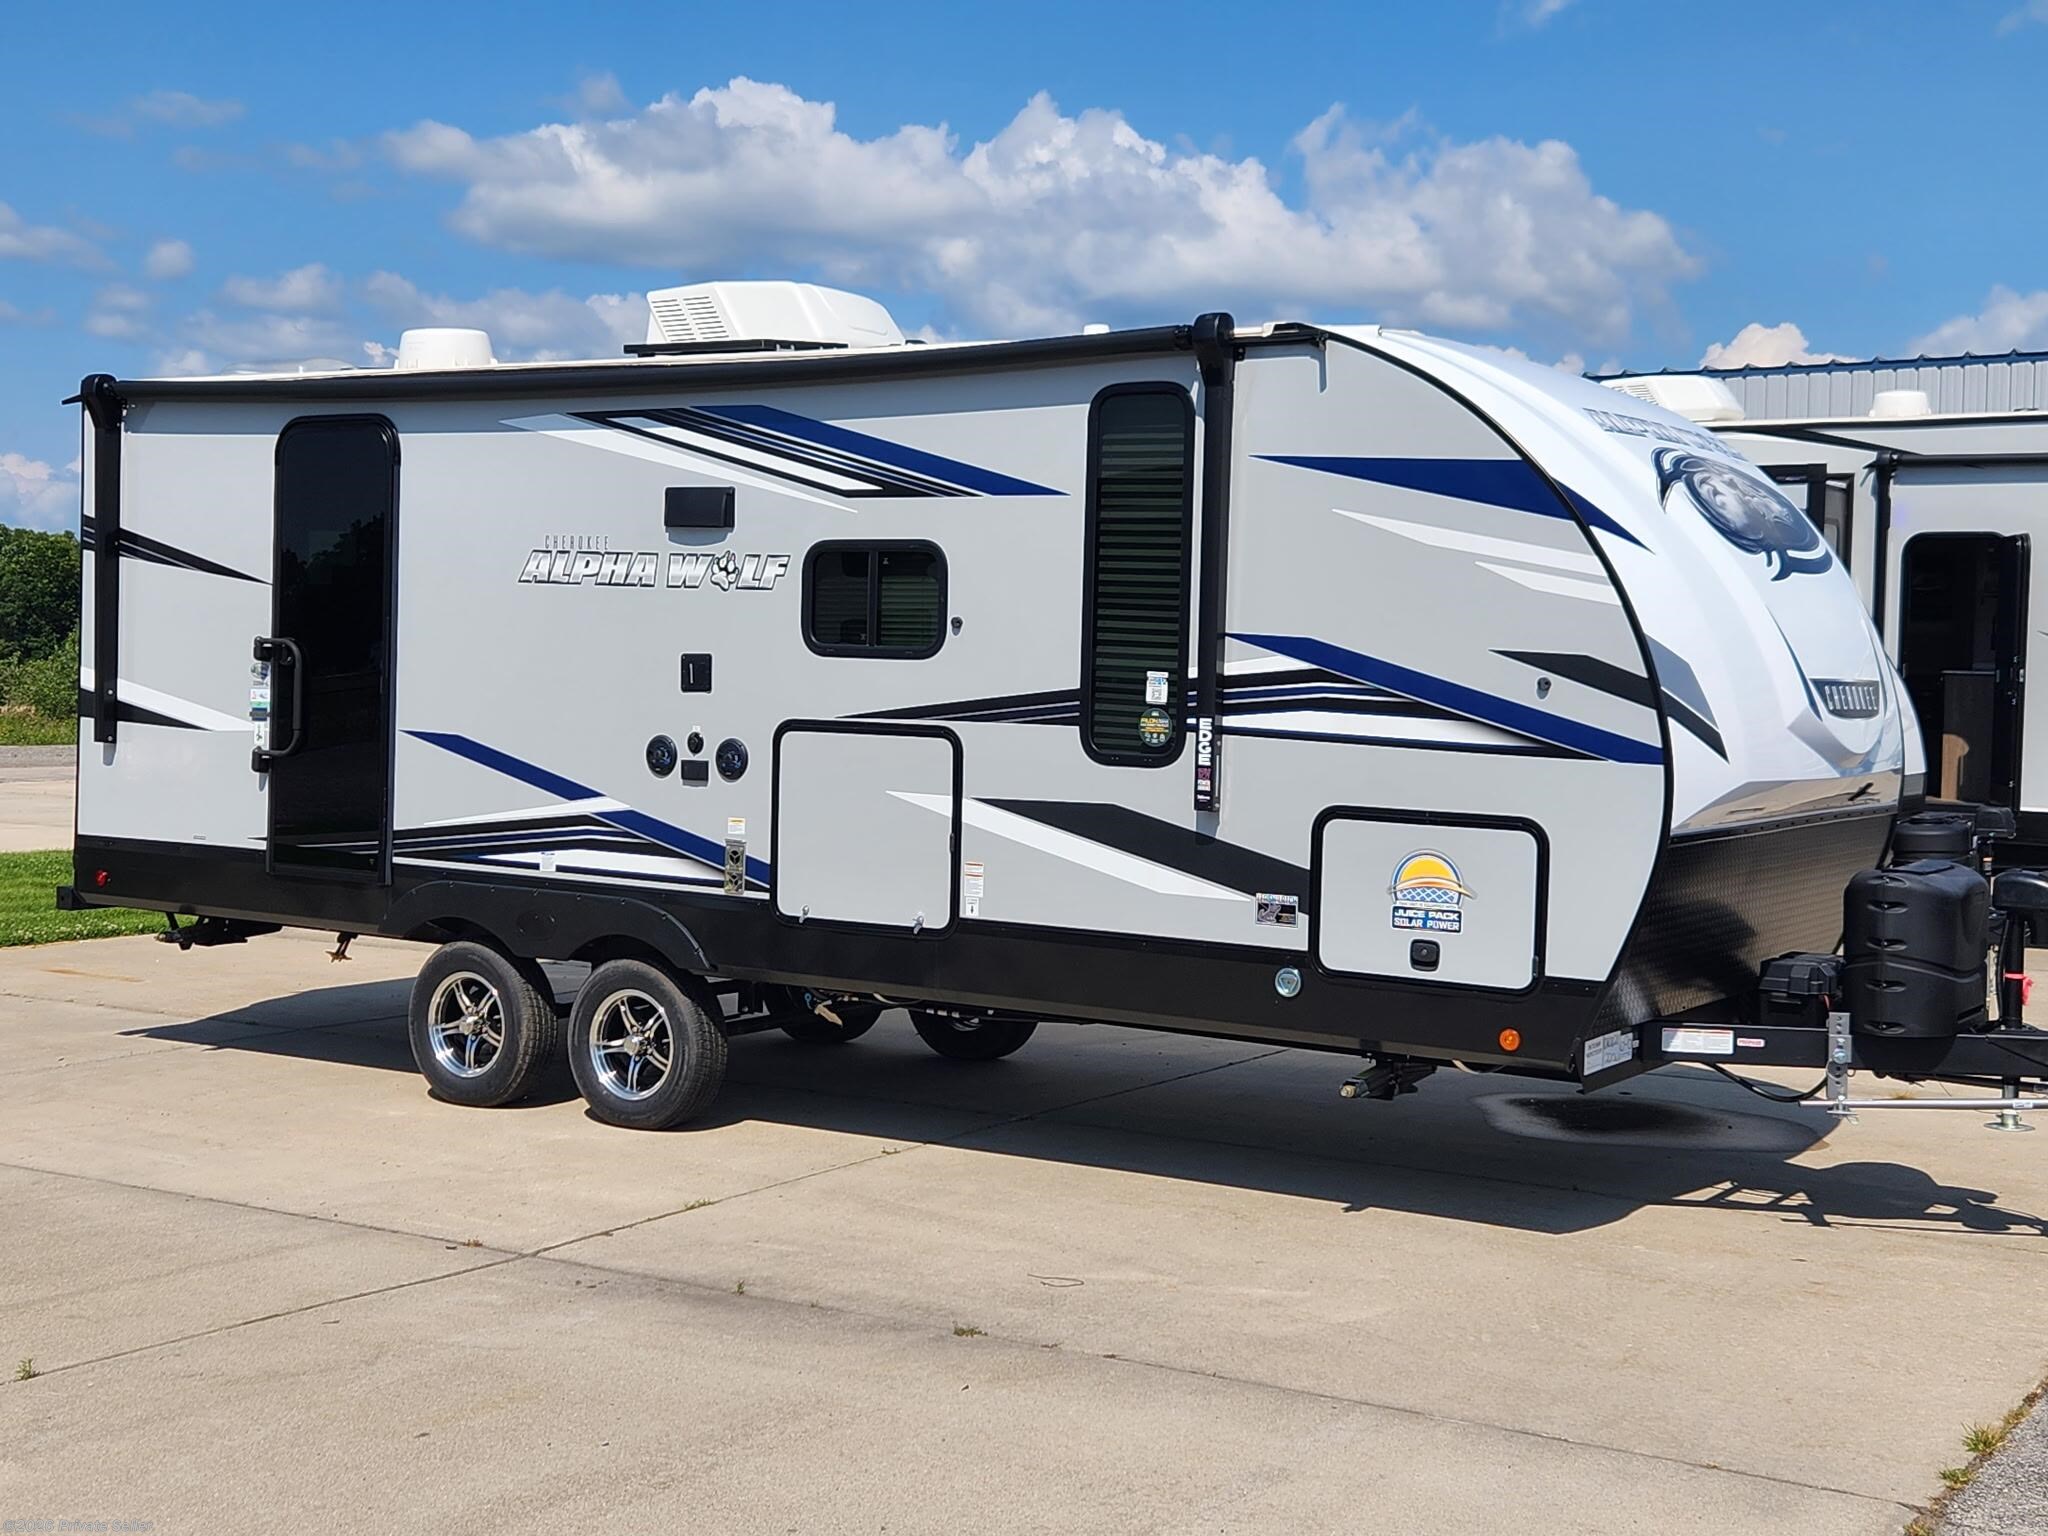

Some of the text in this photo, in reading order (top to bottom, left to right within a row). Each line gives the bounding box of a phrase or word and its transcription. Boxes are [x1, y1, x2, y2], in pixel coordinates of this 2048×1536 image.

[544, 534, 610, 550] CHEROKEE
[518, 549, 659, 587] ALPHA
[1198, 717, 1213, 766] EDGE
[1394, 908, 1460, 921] JUICE PACK
[1393, 917, 1460, 931] SOLAR POWER
